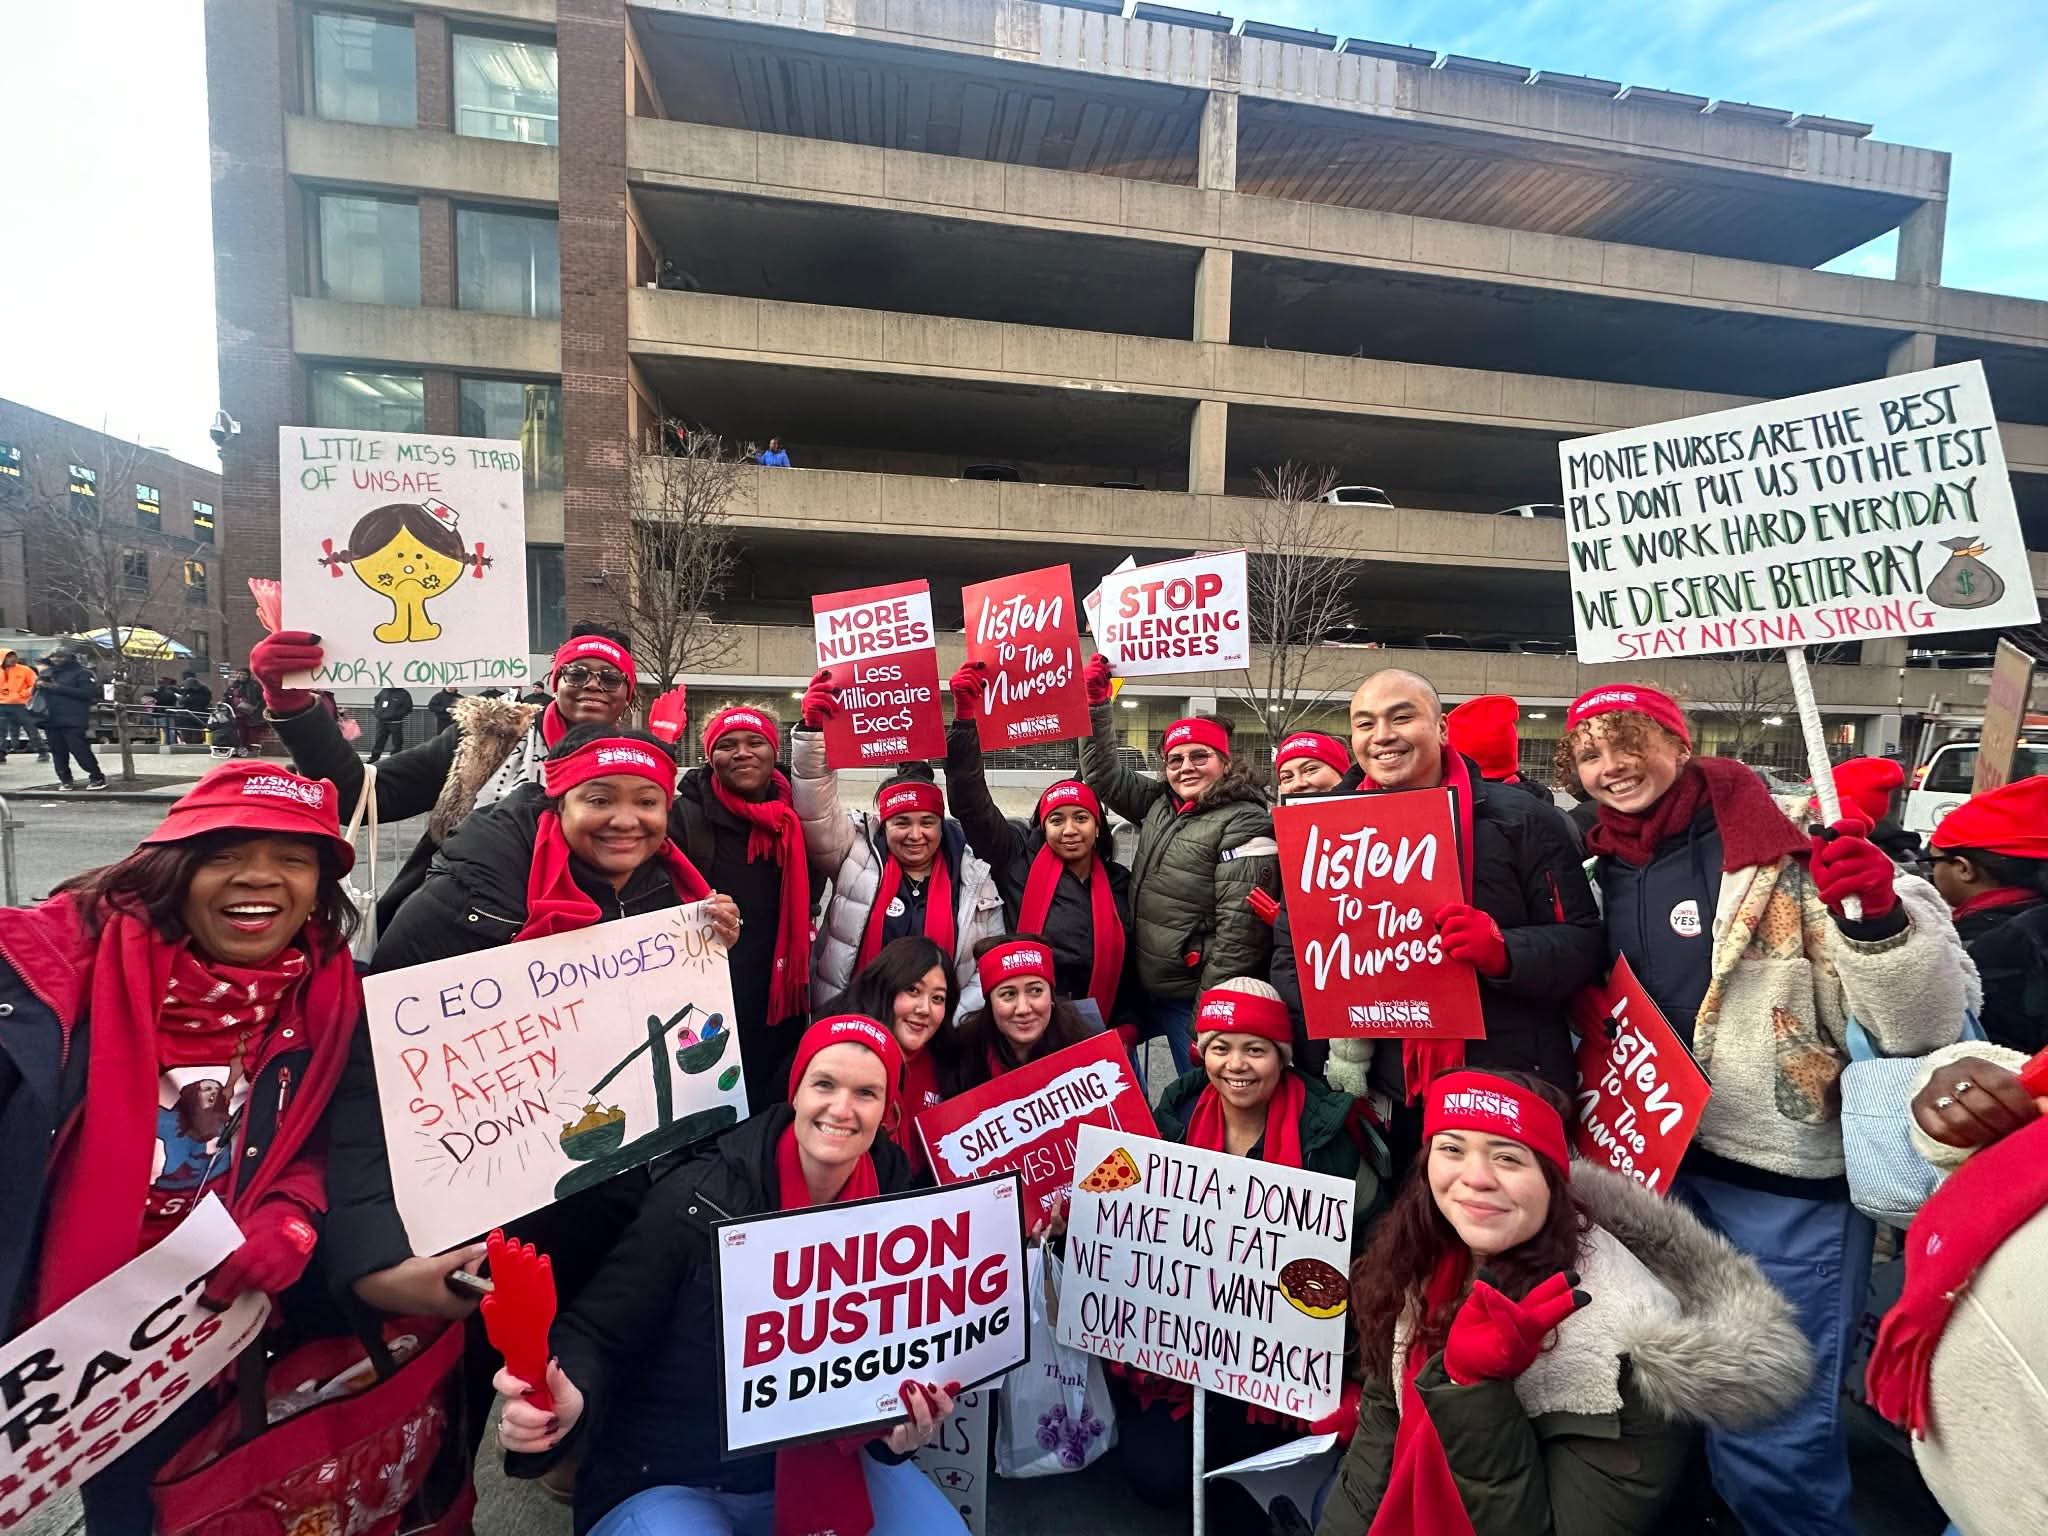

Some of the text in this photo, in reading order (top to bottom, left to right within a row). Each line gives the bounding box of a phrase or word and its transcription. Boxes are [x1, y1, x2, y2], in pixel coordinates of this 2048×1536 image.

[300, 436, 521, 472] LITTLE MISS TIRED
[1569, 384, 1960, 490] MONTE NURSES ARE THE BEST
[300, 465, 443, 494] OF UNSAFE
[1569, 492, 1611, 533] PLS
[1695, 469, 1743, 513] PUT
[1754, 461, 1799, 498] US
[1801, 454, 1846, 492] TO
[1843, 440, 1912, 484] THE
[1914, 425, 1992, 474] TEST
[1571, 476, 1979, 572] WE WORK HARD EVERYDAY
[1118, 573, 1223, 619] STOP
[1576, 540, 1924, 631] WE DESERVE BETTER PAY
[818, 622, 929, 662] NURSES
[829, 601, 910, 636] MORE
[1106, 609, 1240, 643] SILENCING
[1120, 634, 1220, 662] NURSES
[1613, 598, 1938, 659] STAY NYSNA STRONG
[311, 657, 528, 689] WORK CONDITIONS
[853, 664, 903, 685] Less
[852, 706, 913, 734] Exec$
[861, 739, 908, 754] NURSES
[1007, 717, 1060, 735] NURSES
[246, 776, 298, 790] NYSNA
[1673, 916, 1696, 926] YES
[394, 924, 715, 1036] CEO BONUSES UP
[1348, 1006, 1430, 1022] NURSES
[1351, 1020, 1433, 1029] ASSOCIATION
[401, 999, 585, 1091] PATIENT
[410, 1046, 558, 1126] SAFETY
[1443, 1094, 1520, 1120] NURSES
[439, 1090, 551, 1164] DOWN
[959, 1072, 1108, 1162] SAFE STAFFING
[1144, 1152, 1222, 1211] PIZZA
[1243, 1175, 1348, 1242] DONUTS
[772, 1210, 971, 1300] UNION
[1096, 1198, 1286, 1272] MAKE US FAT
[743, 1253, 1009, 1368] BUSTING
[1072, 1236, 1281, 1324] WE JUST WANT
[742, 1306, 1010, 1413] IS DISGUSTING
[1076, 1332, 1125, 1360] STAY
[1136, 1347, 1201, 1383] NYSNA
[1214, 1368, 1314, 1413] STRONG!
[1081, 1291, 1332, 1396] OUR PENSION BACK!
